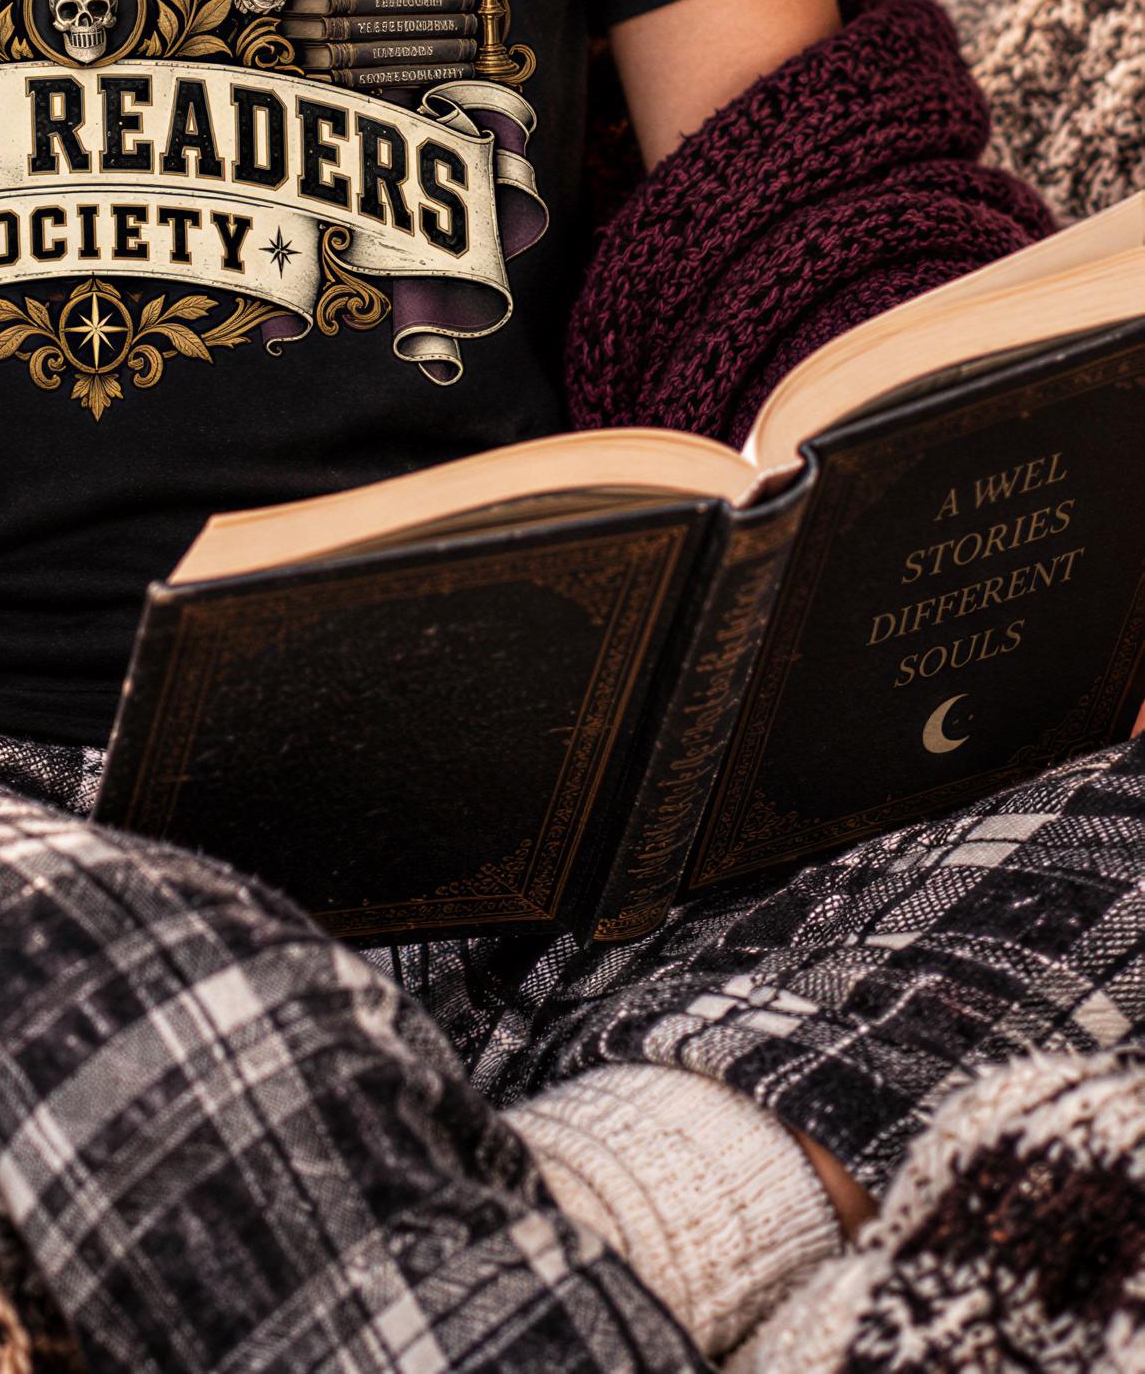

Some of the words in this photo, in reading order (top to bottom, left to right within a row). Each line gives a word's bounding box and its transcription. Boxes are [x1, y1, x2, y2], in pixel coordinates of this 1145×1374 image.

[25, 75, 471, 259] READERS
[902, 499, 1075, 585] STORIES
[934, 488, 960, 521] A
[866, 547, 1085, 646] DIFFERENT
[893, 619, 1025, 688] SOULS
